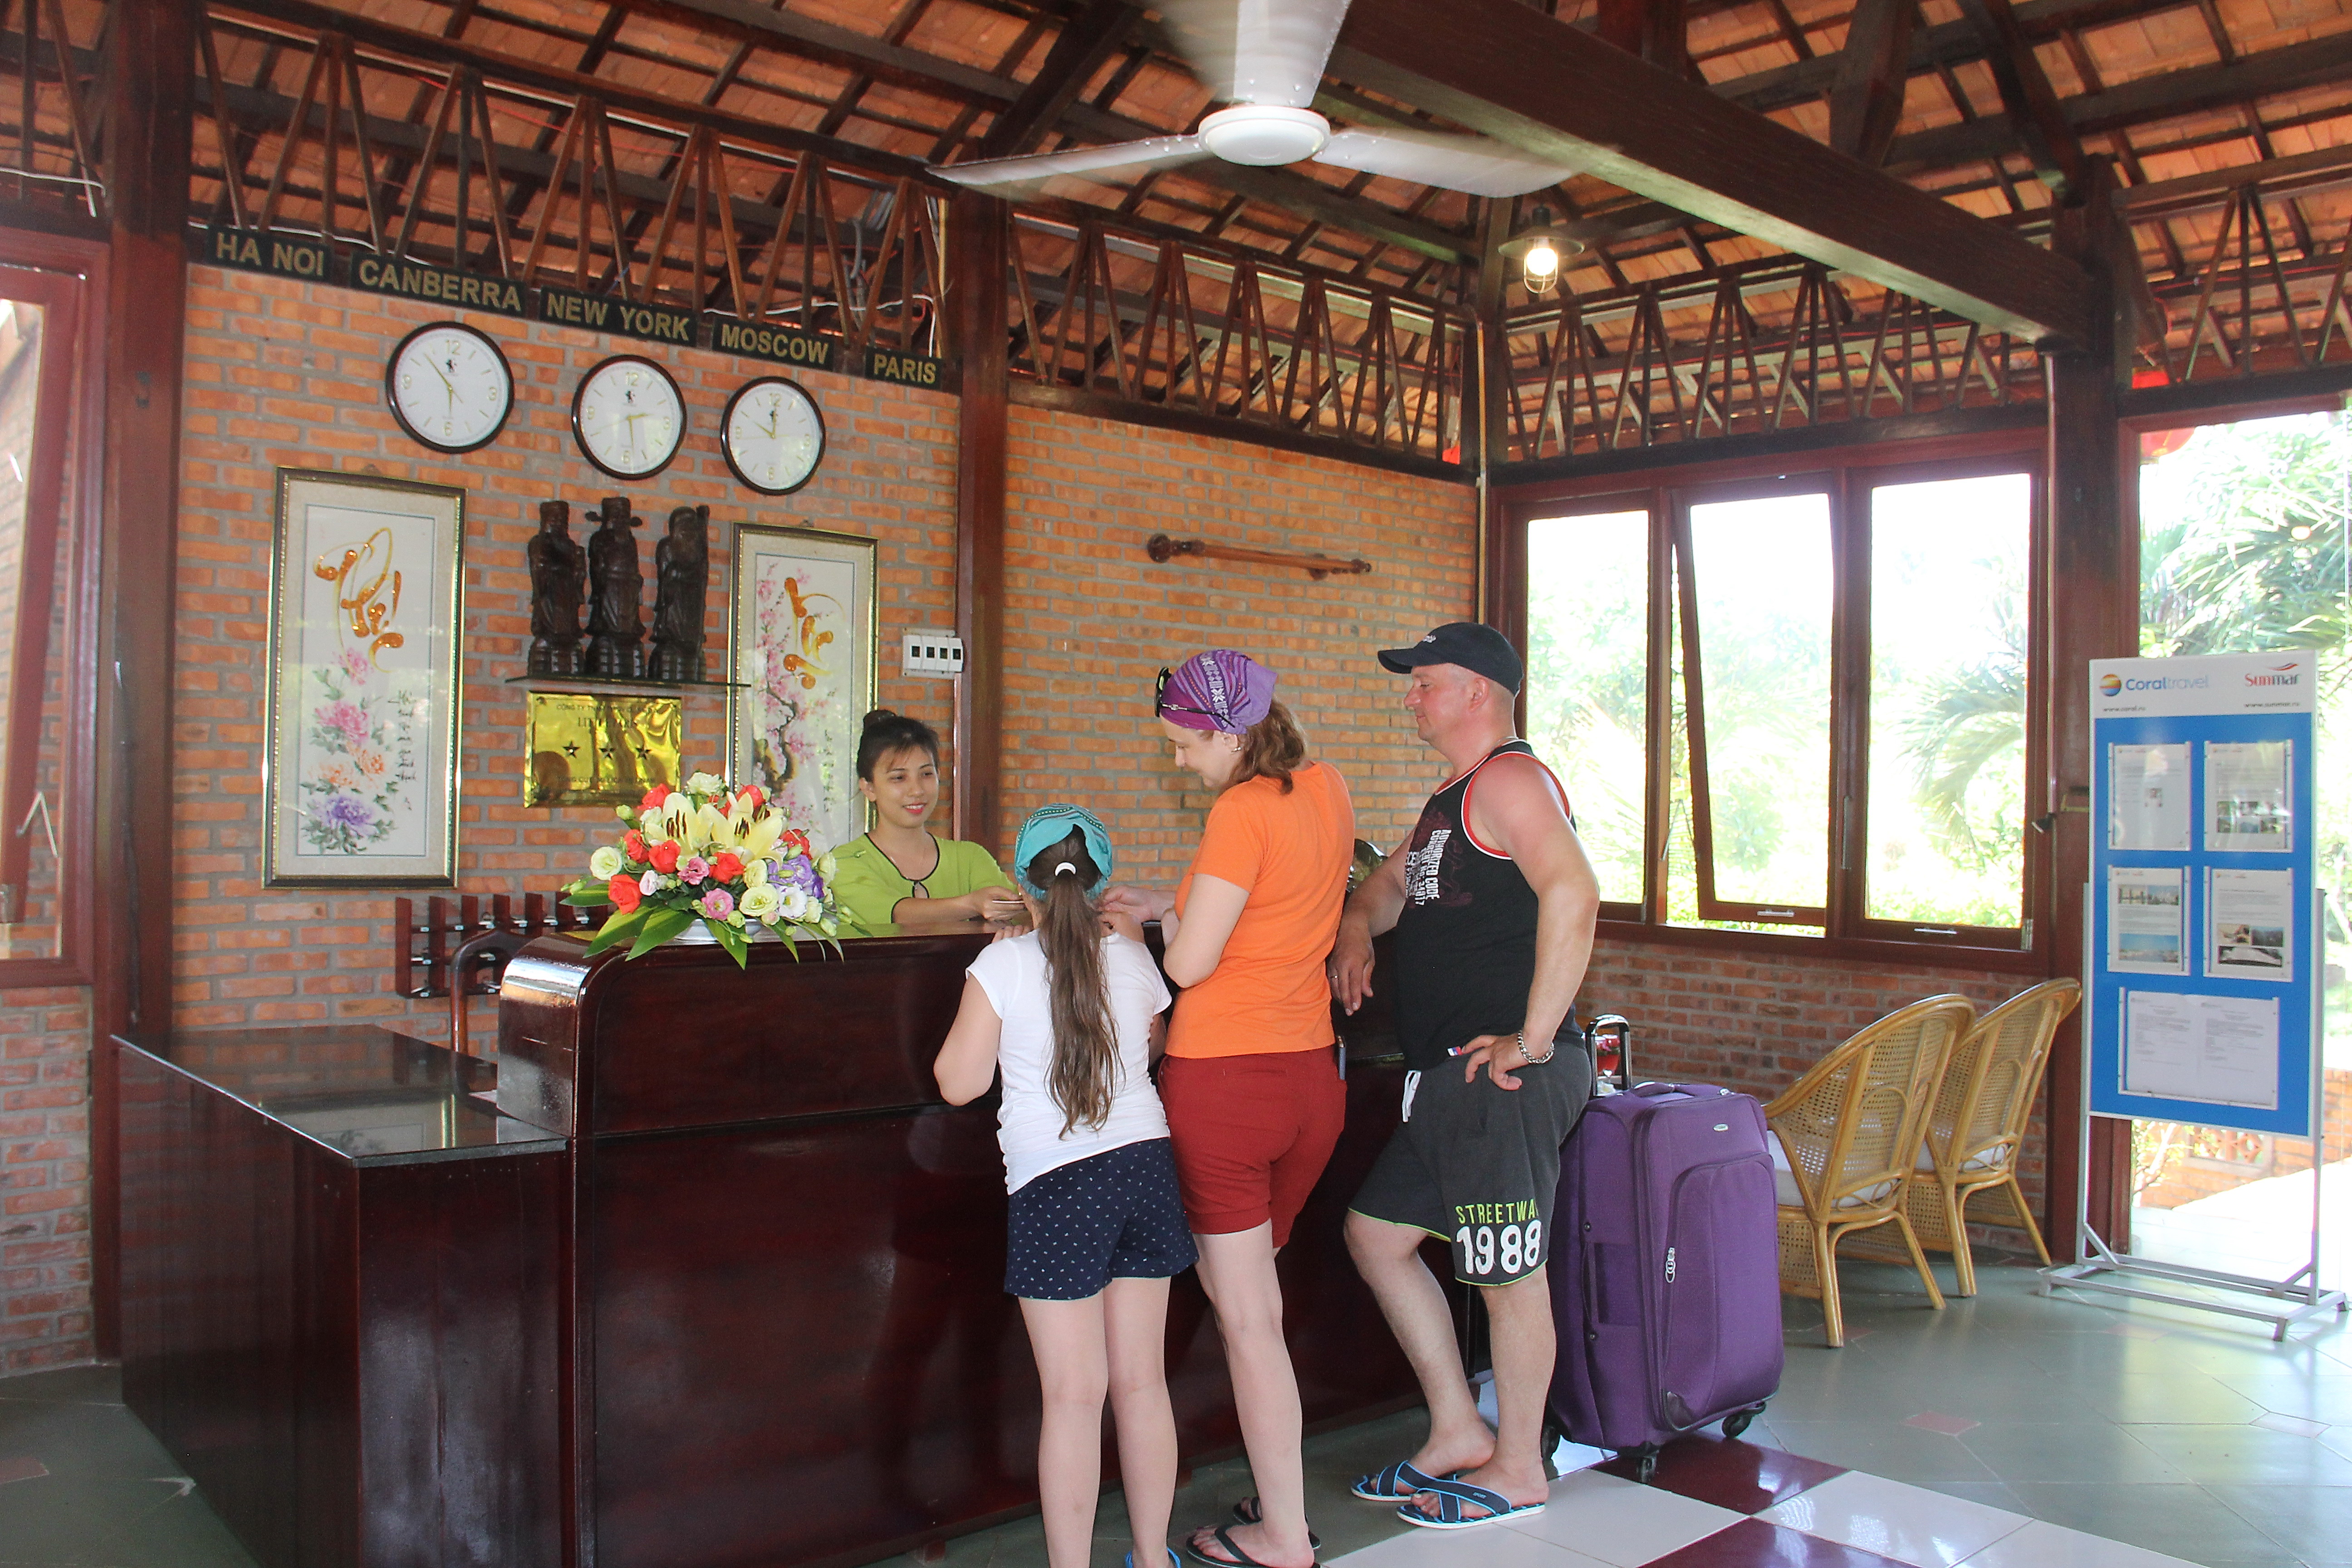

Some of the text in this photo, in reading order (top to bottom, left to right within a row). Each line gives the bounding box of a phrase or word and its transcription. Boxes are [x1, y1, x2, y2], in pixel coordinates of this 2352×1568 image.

[216, 232, 324, 276] HA NOI
[359, 259, 522, 312] CANBERRA
[547, 292, 689, 341] NEW YORK
[446, 339, 461, 356] 12
[721, 323, 829, 364] MOSCOW
[626, 372, 639, 387] 12
[873, 353, 936, 384] PARIS
[401, 374, 412, 389] 9
[487, 387, 497, 401] 3
[769, 392, 782, 407] 12
[586, 406, 595, 420] 9
[443, 421, 452, 436] 6
[622, 450, 630, 464] 6
[1422, 829, 1441, 864] CURRENT
[1425, 829, 1452, 900] AUTHORIZED CODE
[1455, 1219, 1542, 1275] 1988
